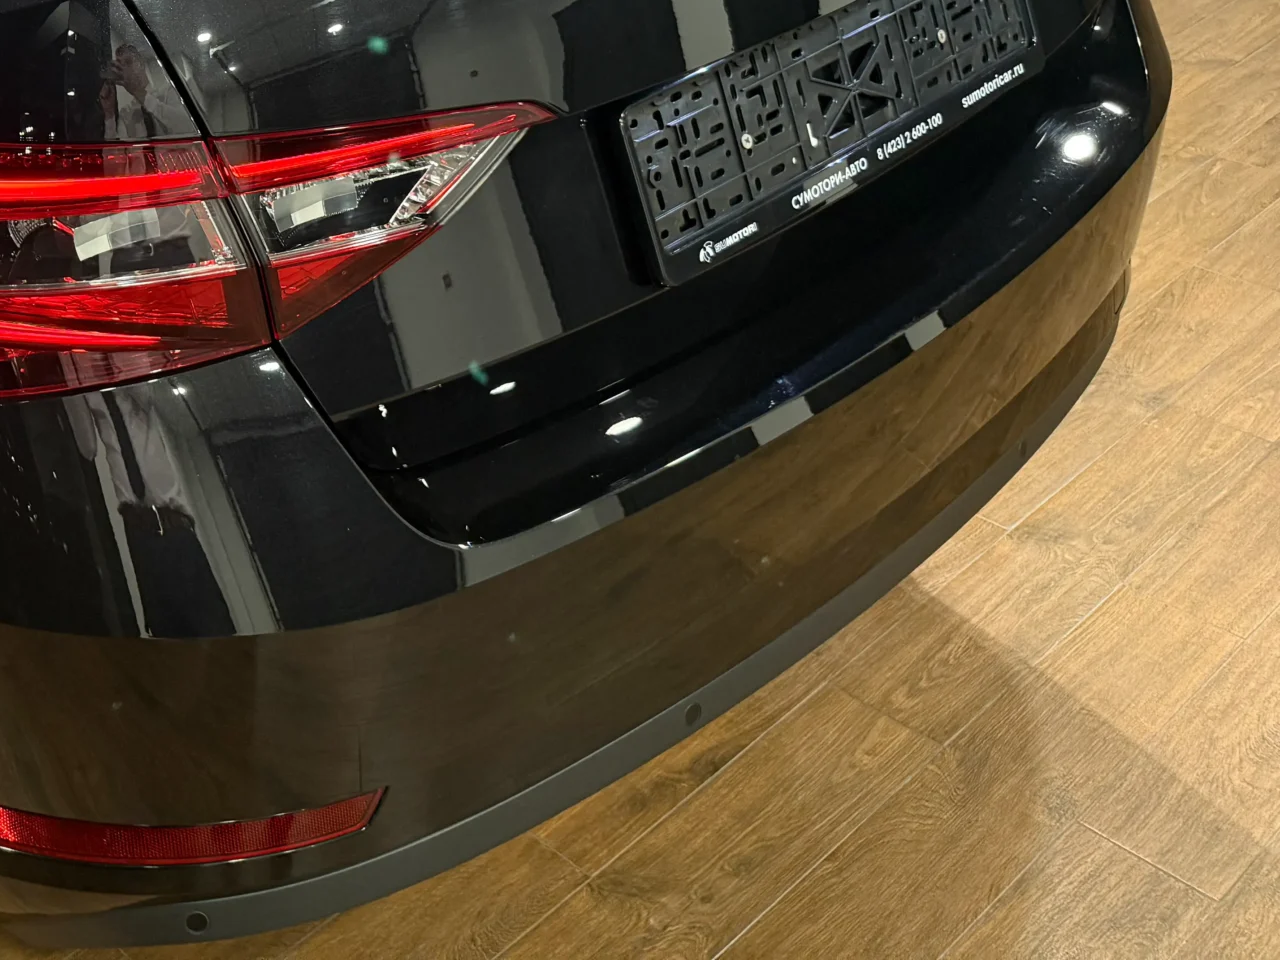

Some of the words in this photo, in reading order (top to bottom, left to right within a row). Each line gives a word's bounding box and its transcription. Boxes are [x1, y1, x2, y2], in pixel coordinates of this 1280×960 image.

[961, 63, 1025, 108] sumotoricar.ru
[791, 157, 868, 209] СУМОТОРИ-АВТО
[876, 148, 884, 160] 8
[883, 134, 906, 159] (423)
[904, 132, 913, 144] 2
[912, 113, 943, 140] 600-100
[714, 222, 758, 253] SUMOTORI
